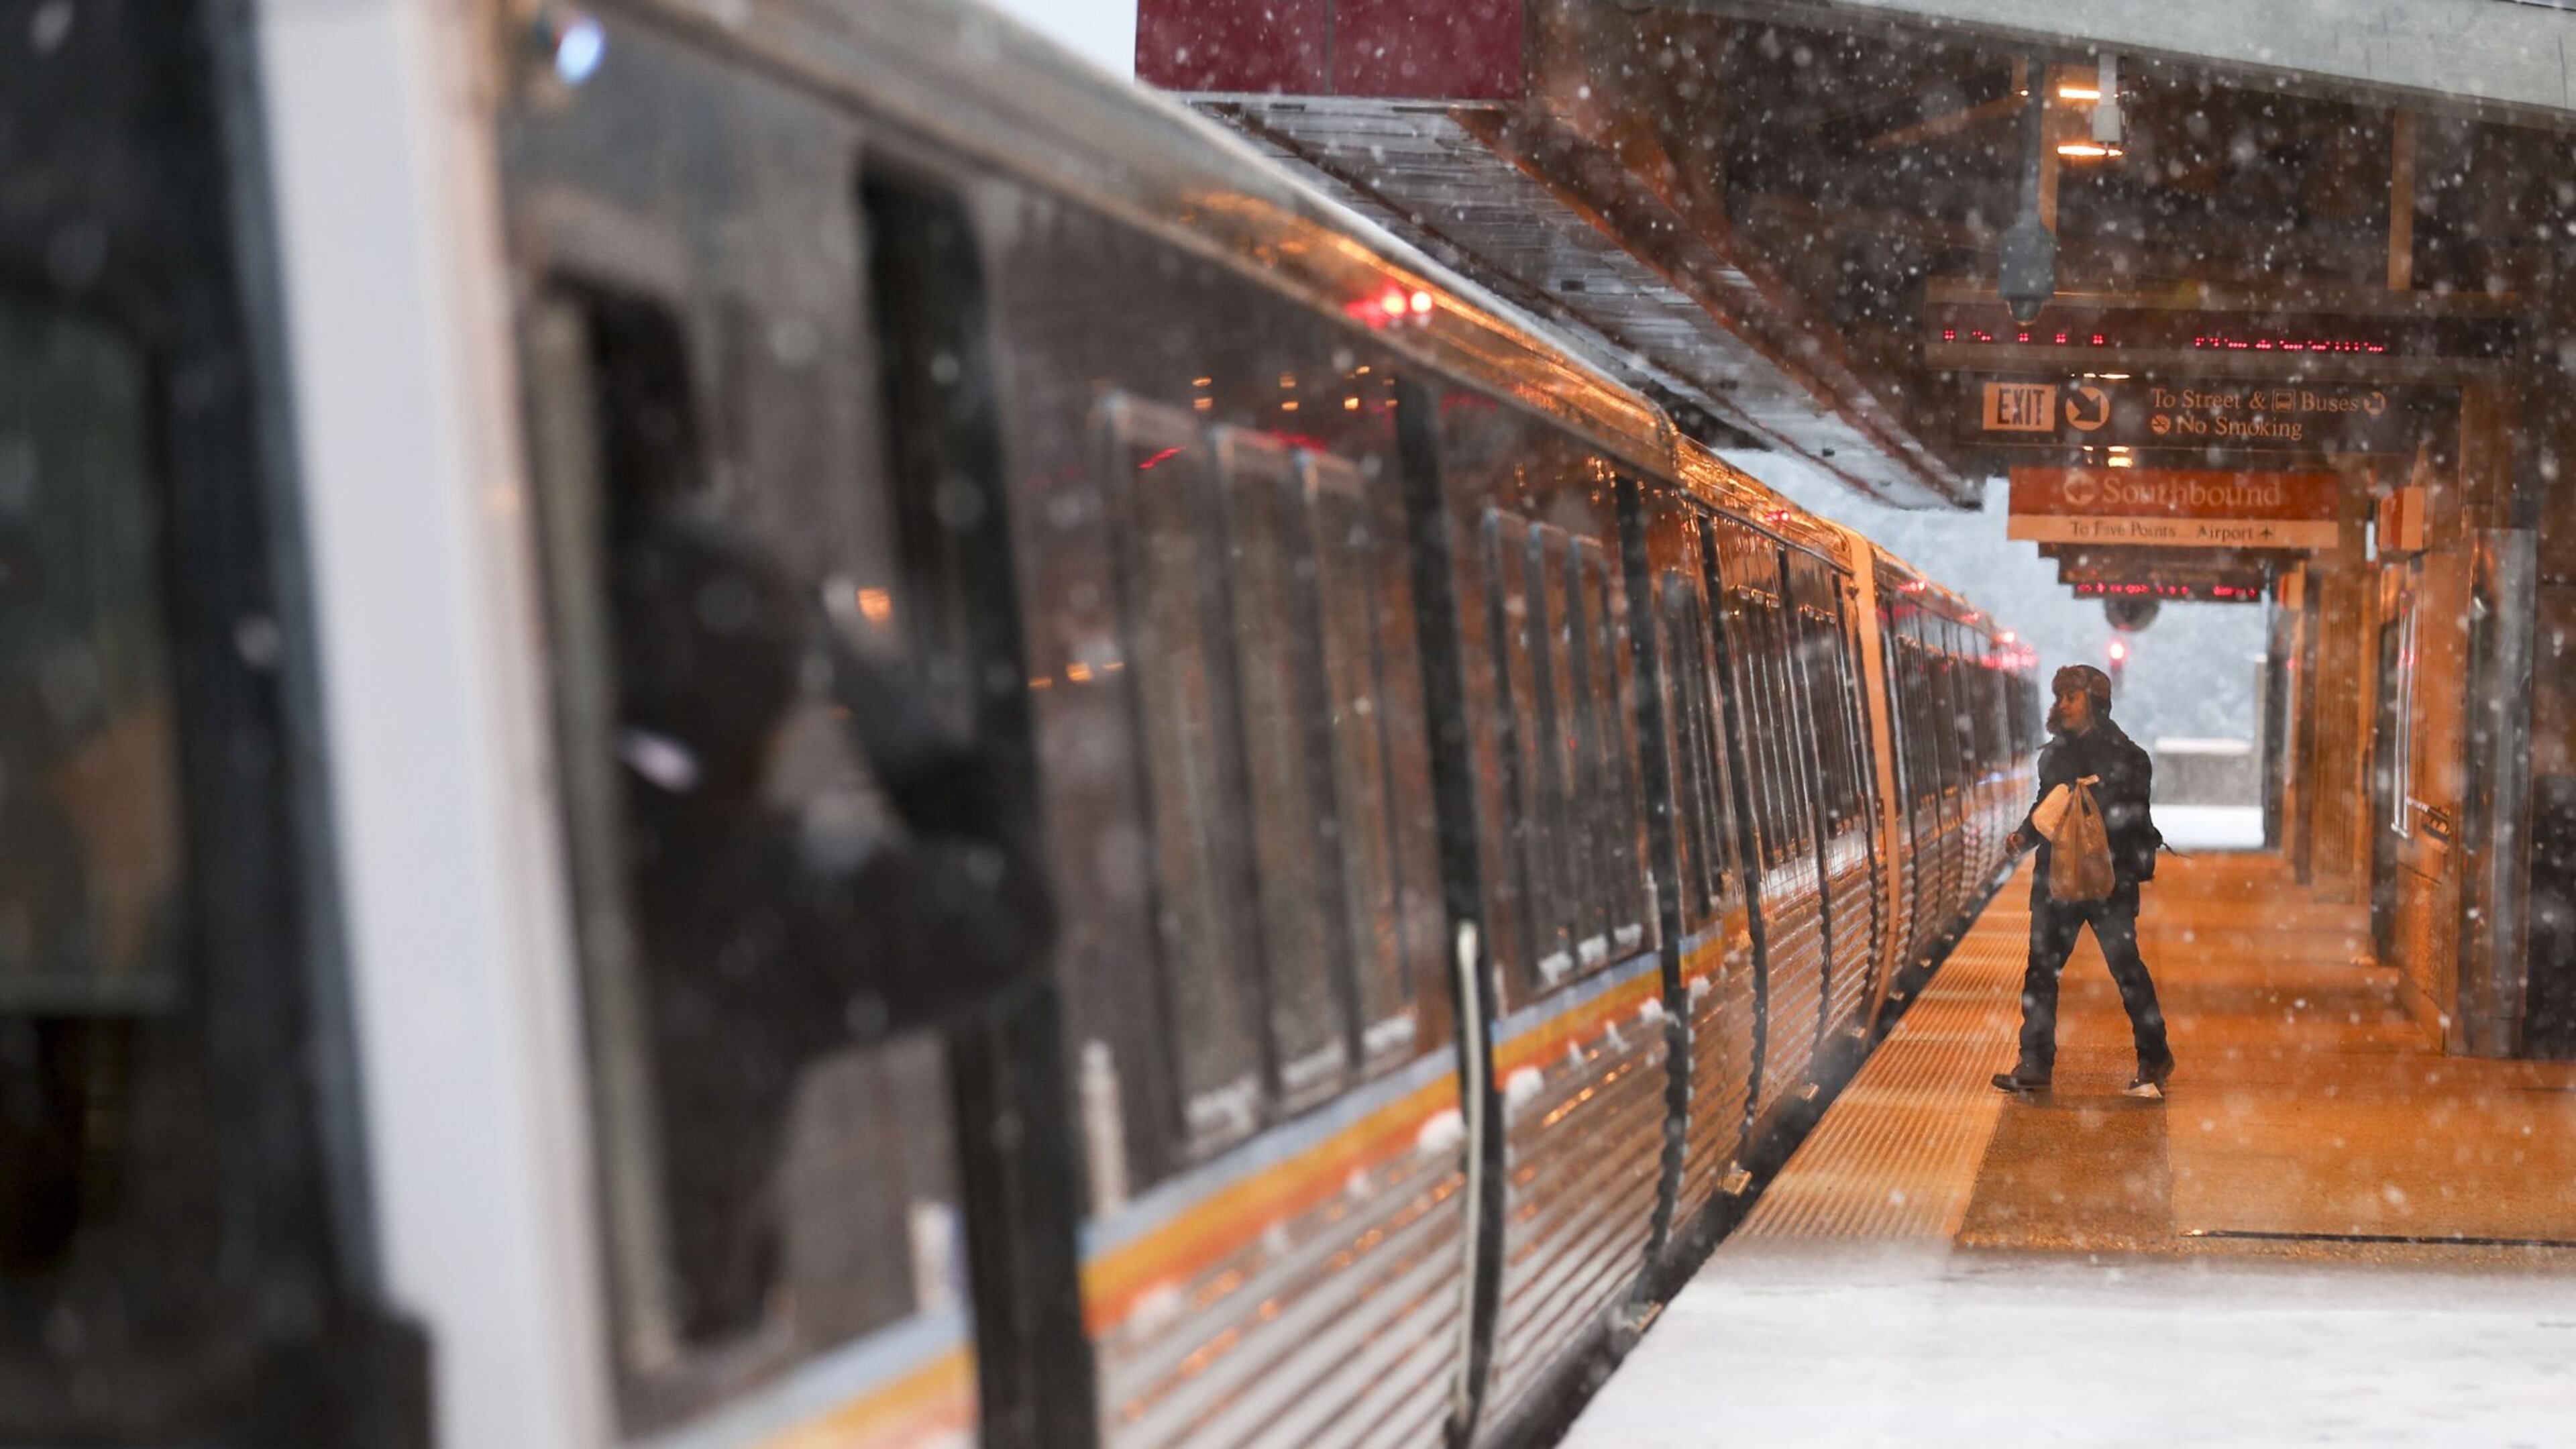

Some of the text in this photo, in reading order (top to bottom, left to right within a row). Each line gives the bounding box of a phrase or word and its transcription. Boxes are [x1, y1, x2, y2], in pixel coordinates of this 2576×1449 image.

[1996, 388, 2045, 426] EXIT
[2151, 388, 2359, 413] To Street & Buses
[2177, 417, 2303, 441] No Smoking
[2102, 478, 2281, 508] Southbound
[2070, 521, 2253, 541] To Five Points Airport
